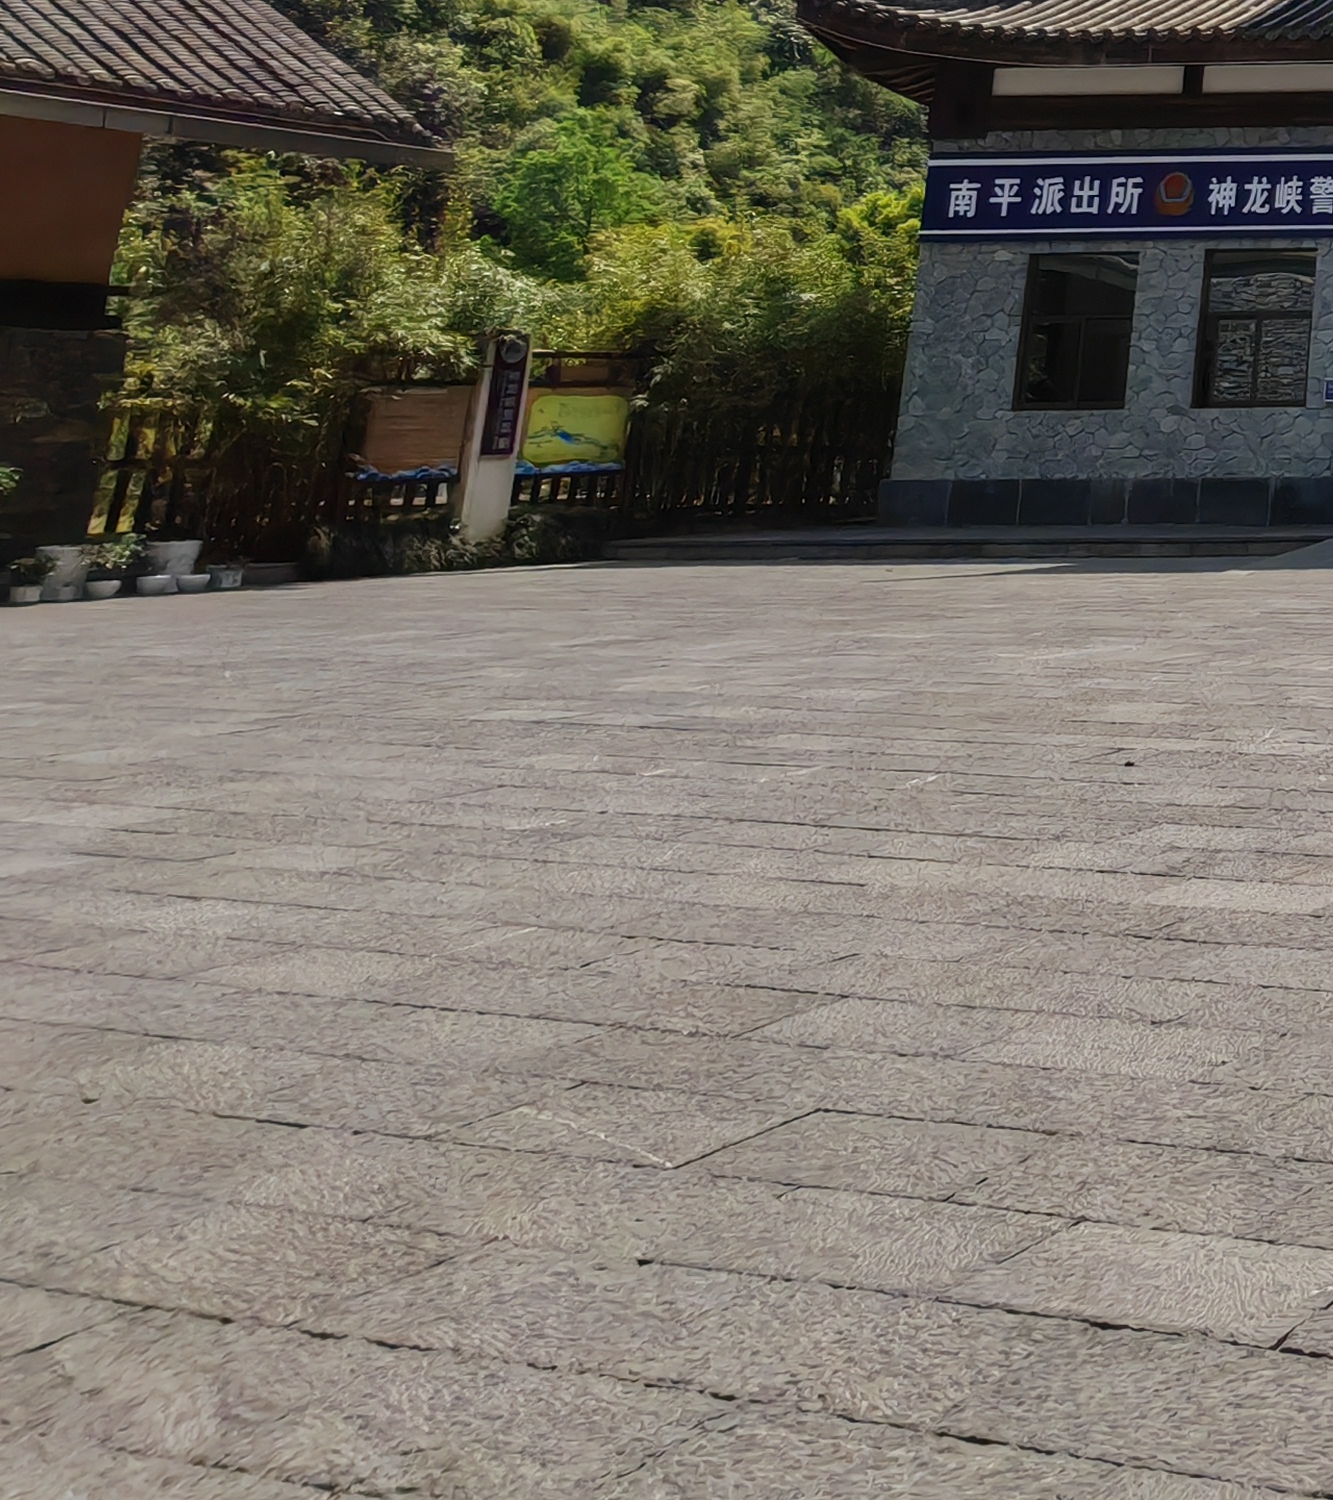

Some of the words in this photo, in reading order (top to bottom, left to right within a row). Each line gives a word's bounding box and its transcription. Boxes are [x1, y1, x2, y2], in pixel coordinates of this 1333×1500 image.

[947, 177, 1144, 217] 南平派出所
